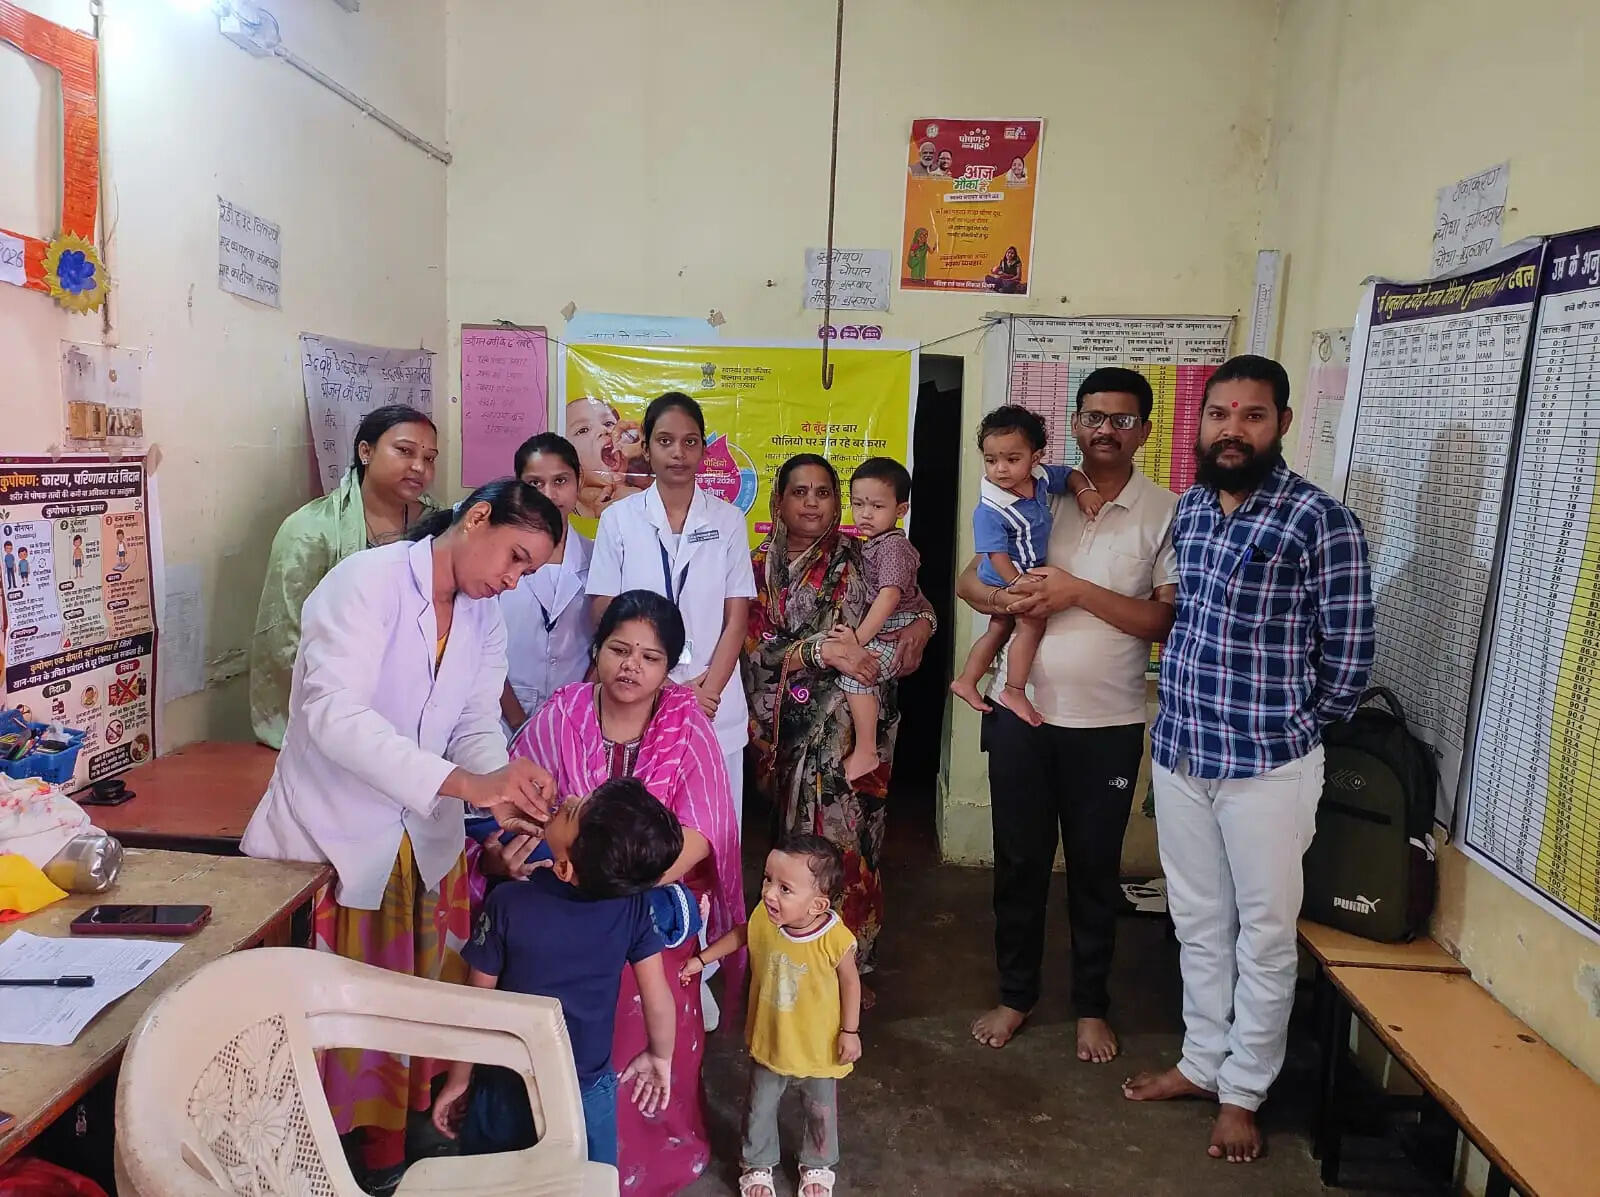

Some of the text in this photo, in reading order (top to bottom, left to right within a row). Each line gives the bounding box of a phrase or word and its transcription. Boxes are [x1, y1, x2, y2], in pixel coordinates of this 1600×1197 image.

[959, 134, 981, 144] पोषण
[954, 176, 978, 191] मौका
[1568, 244, 1580, 277] के
[1477, 351, 1492, 359] MAM
[801, 421, 811, 433] दो
[829, 423, 840, 434] हर
[842, 424, 857, 433] बार
[771, 434, 803, 447] पोलियो
[805, 438, 817, 447] पर
[839, 436, 851, 448] रहे
[852, 439, 887, 449] बरकरार
[0, 469, 141, 492] कुपोषण: कारण, परिणाम एवं निदान
[704, 477, 716, 486] जून
[46, 505, 70, 518] कुपोषण
[1583, 628, 1600, 639] 85.7
[1580, 647, 1598, 657] 86.9
[1578, 656, 1595, 666] 87.5
[1576, 665, 1594, 676] 88.1
[13, 674, 42, 689] खान-पान
[1574, 674, 1592, 684] 88.7
[1573, 683, 1590, 694] 89.2
[1569, 701, 1586, 712] 90.3
[1567, 710, 1585, 721] 90.9
[1566, 719, 1583, 730] 91.4
[1563, 737, 1579, 748] 92.4
[1562, 746, 1578, 757] 93.0
[1560, 763, 1576, 775] 94.0
[1547, 885, 1567, 901] 100.7
[1333, 896, 1369, 914] PUMA
